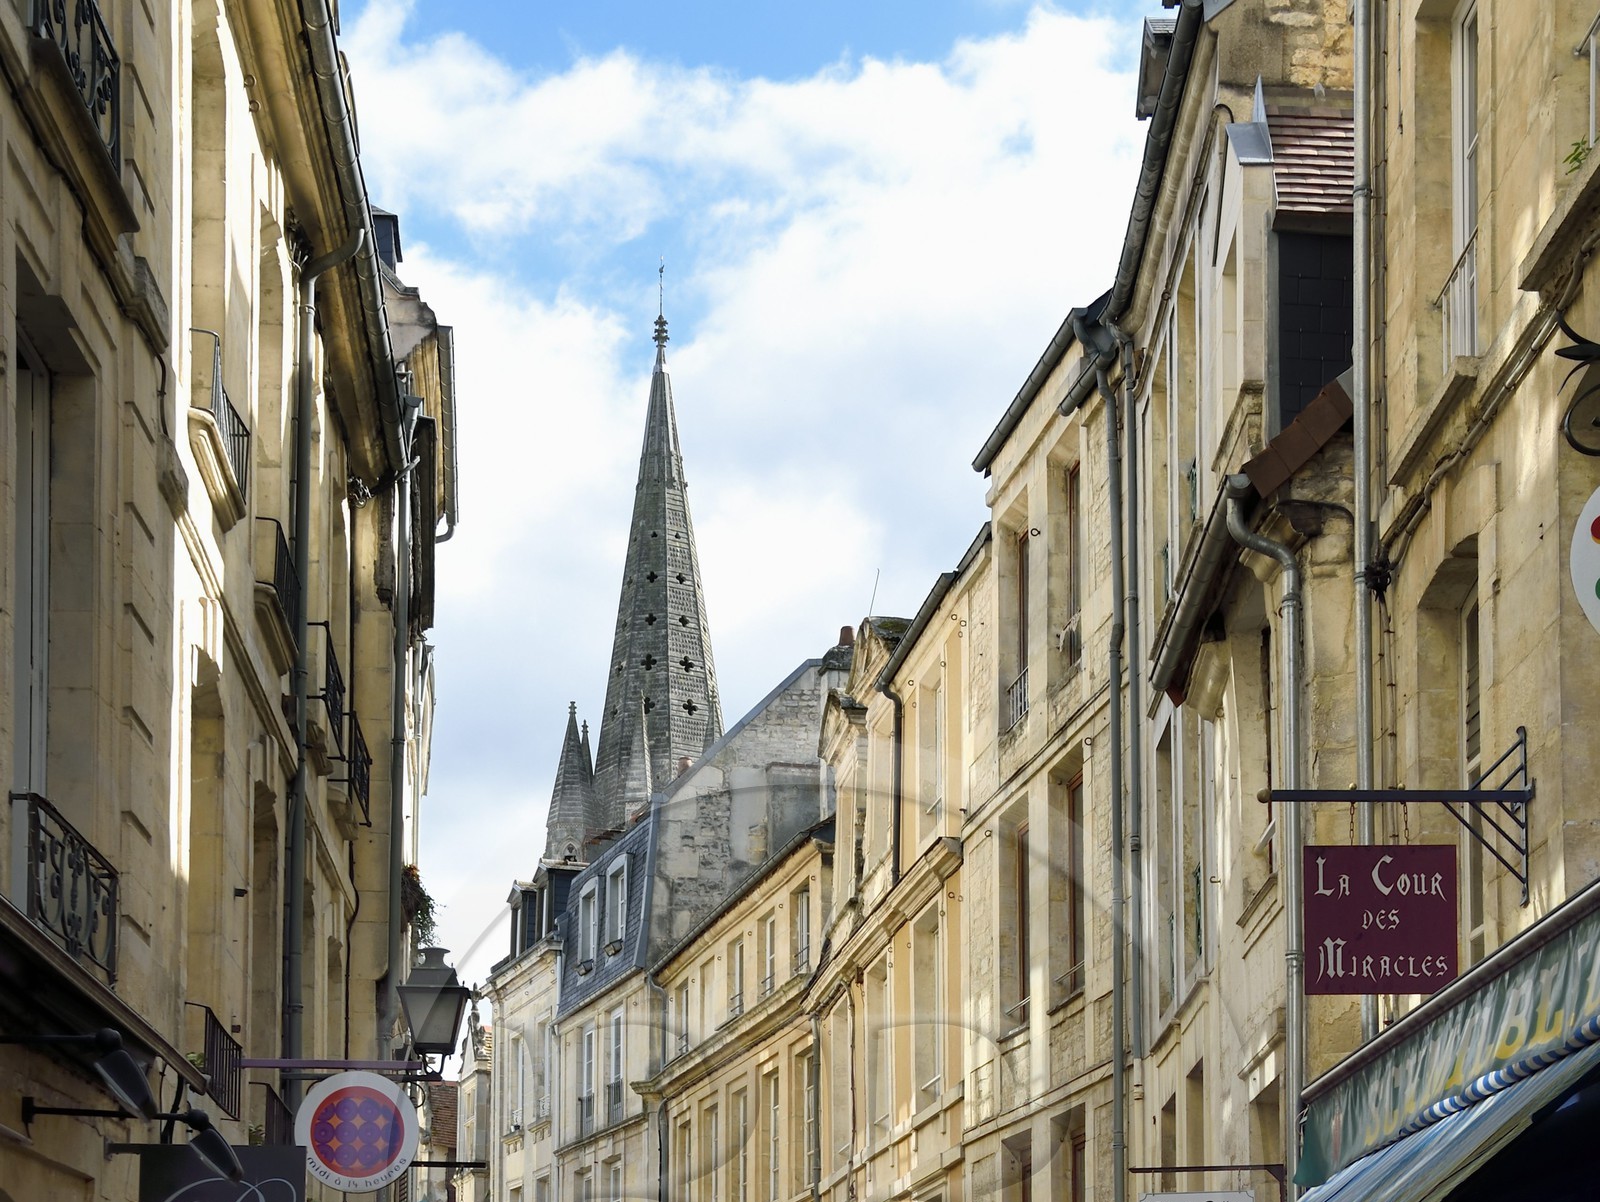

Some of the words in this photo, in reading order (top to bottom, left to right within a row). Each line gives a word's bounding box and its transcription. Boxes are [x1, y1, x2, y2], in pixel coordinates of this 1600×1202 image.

[307, 1157, 331, 1180] midi
[334, 1178, 341, 1186] à
[347, 1180, 358, 1188] 14
[365, 1158, 407, 1187] heures
